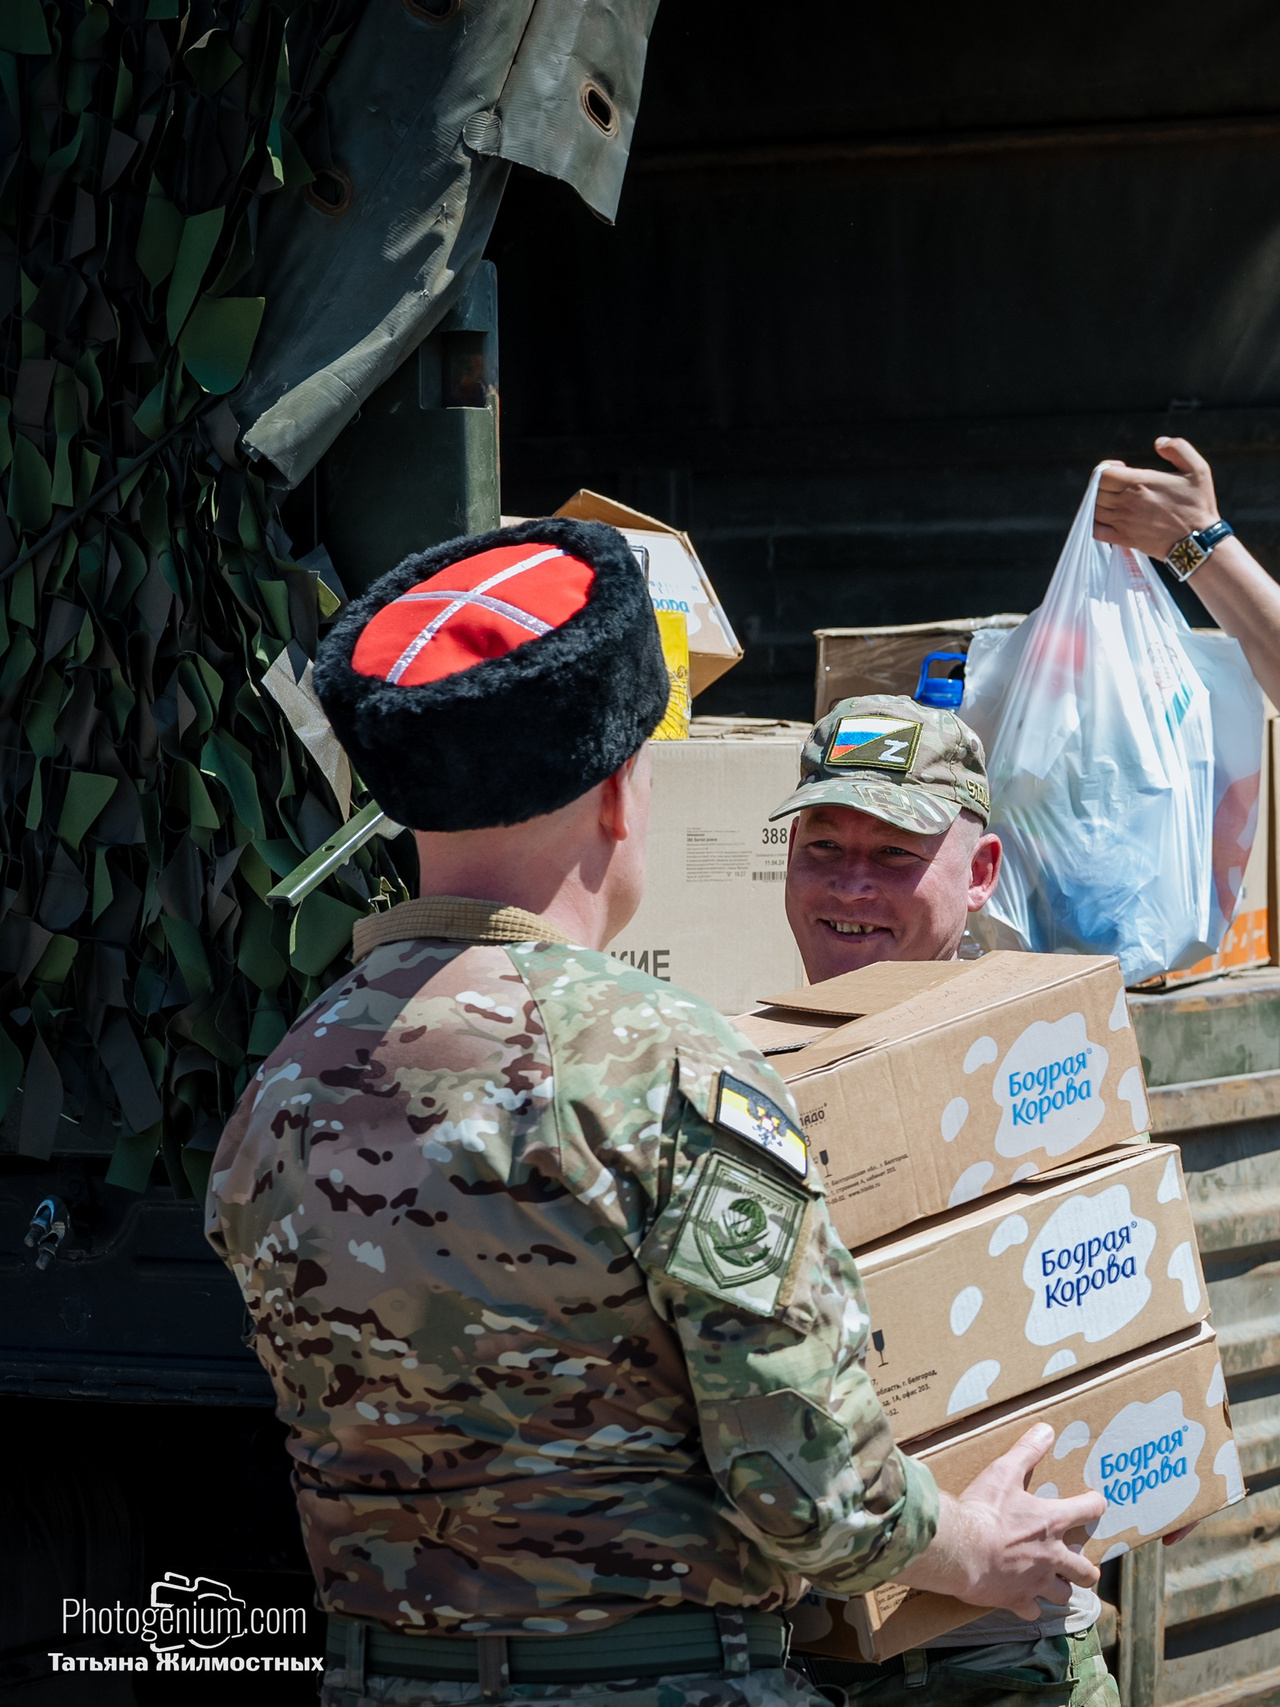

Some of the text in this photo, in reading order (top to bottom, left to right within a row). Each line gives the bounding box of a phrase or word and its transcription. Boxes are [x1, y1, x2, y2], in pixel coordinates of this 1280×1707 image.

[878, 739, 909, 762] Z
[762, 828, 788, 844] 388
[1012, 1077, 1091, 1126] Корова
[1045, 1254, 1137, 1309] Корова
[902, 1389, 918, 1399] офис
[1104, 1455, 1187, 1507] Корова
